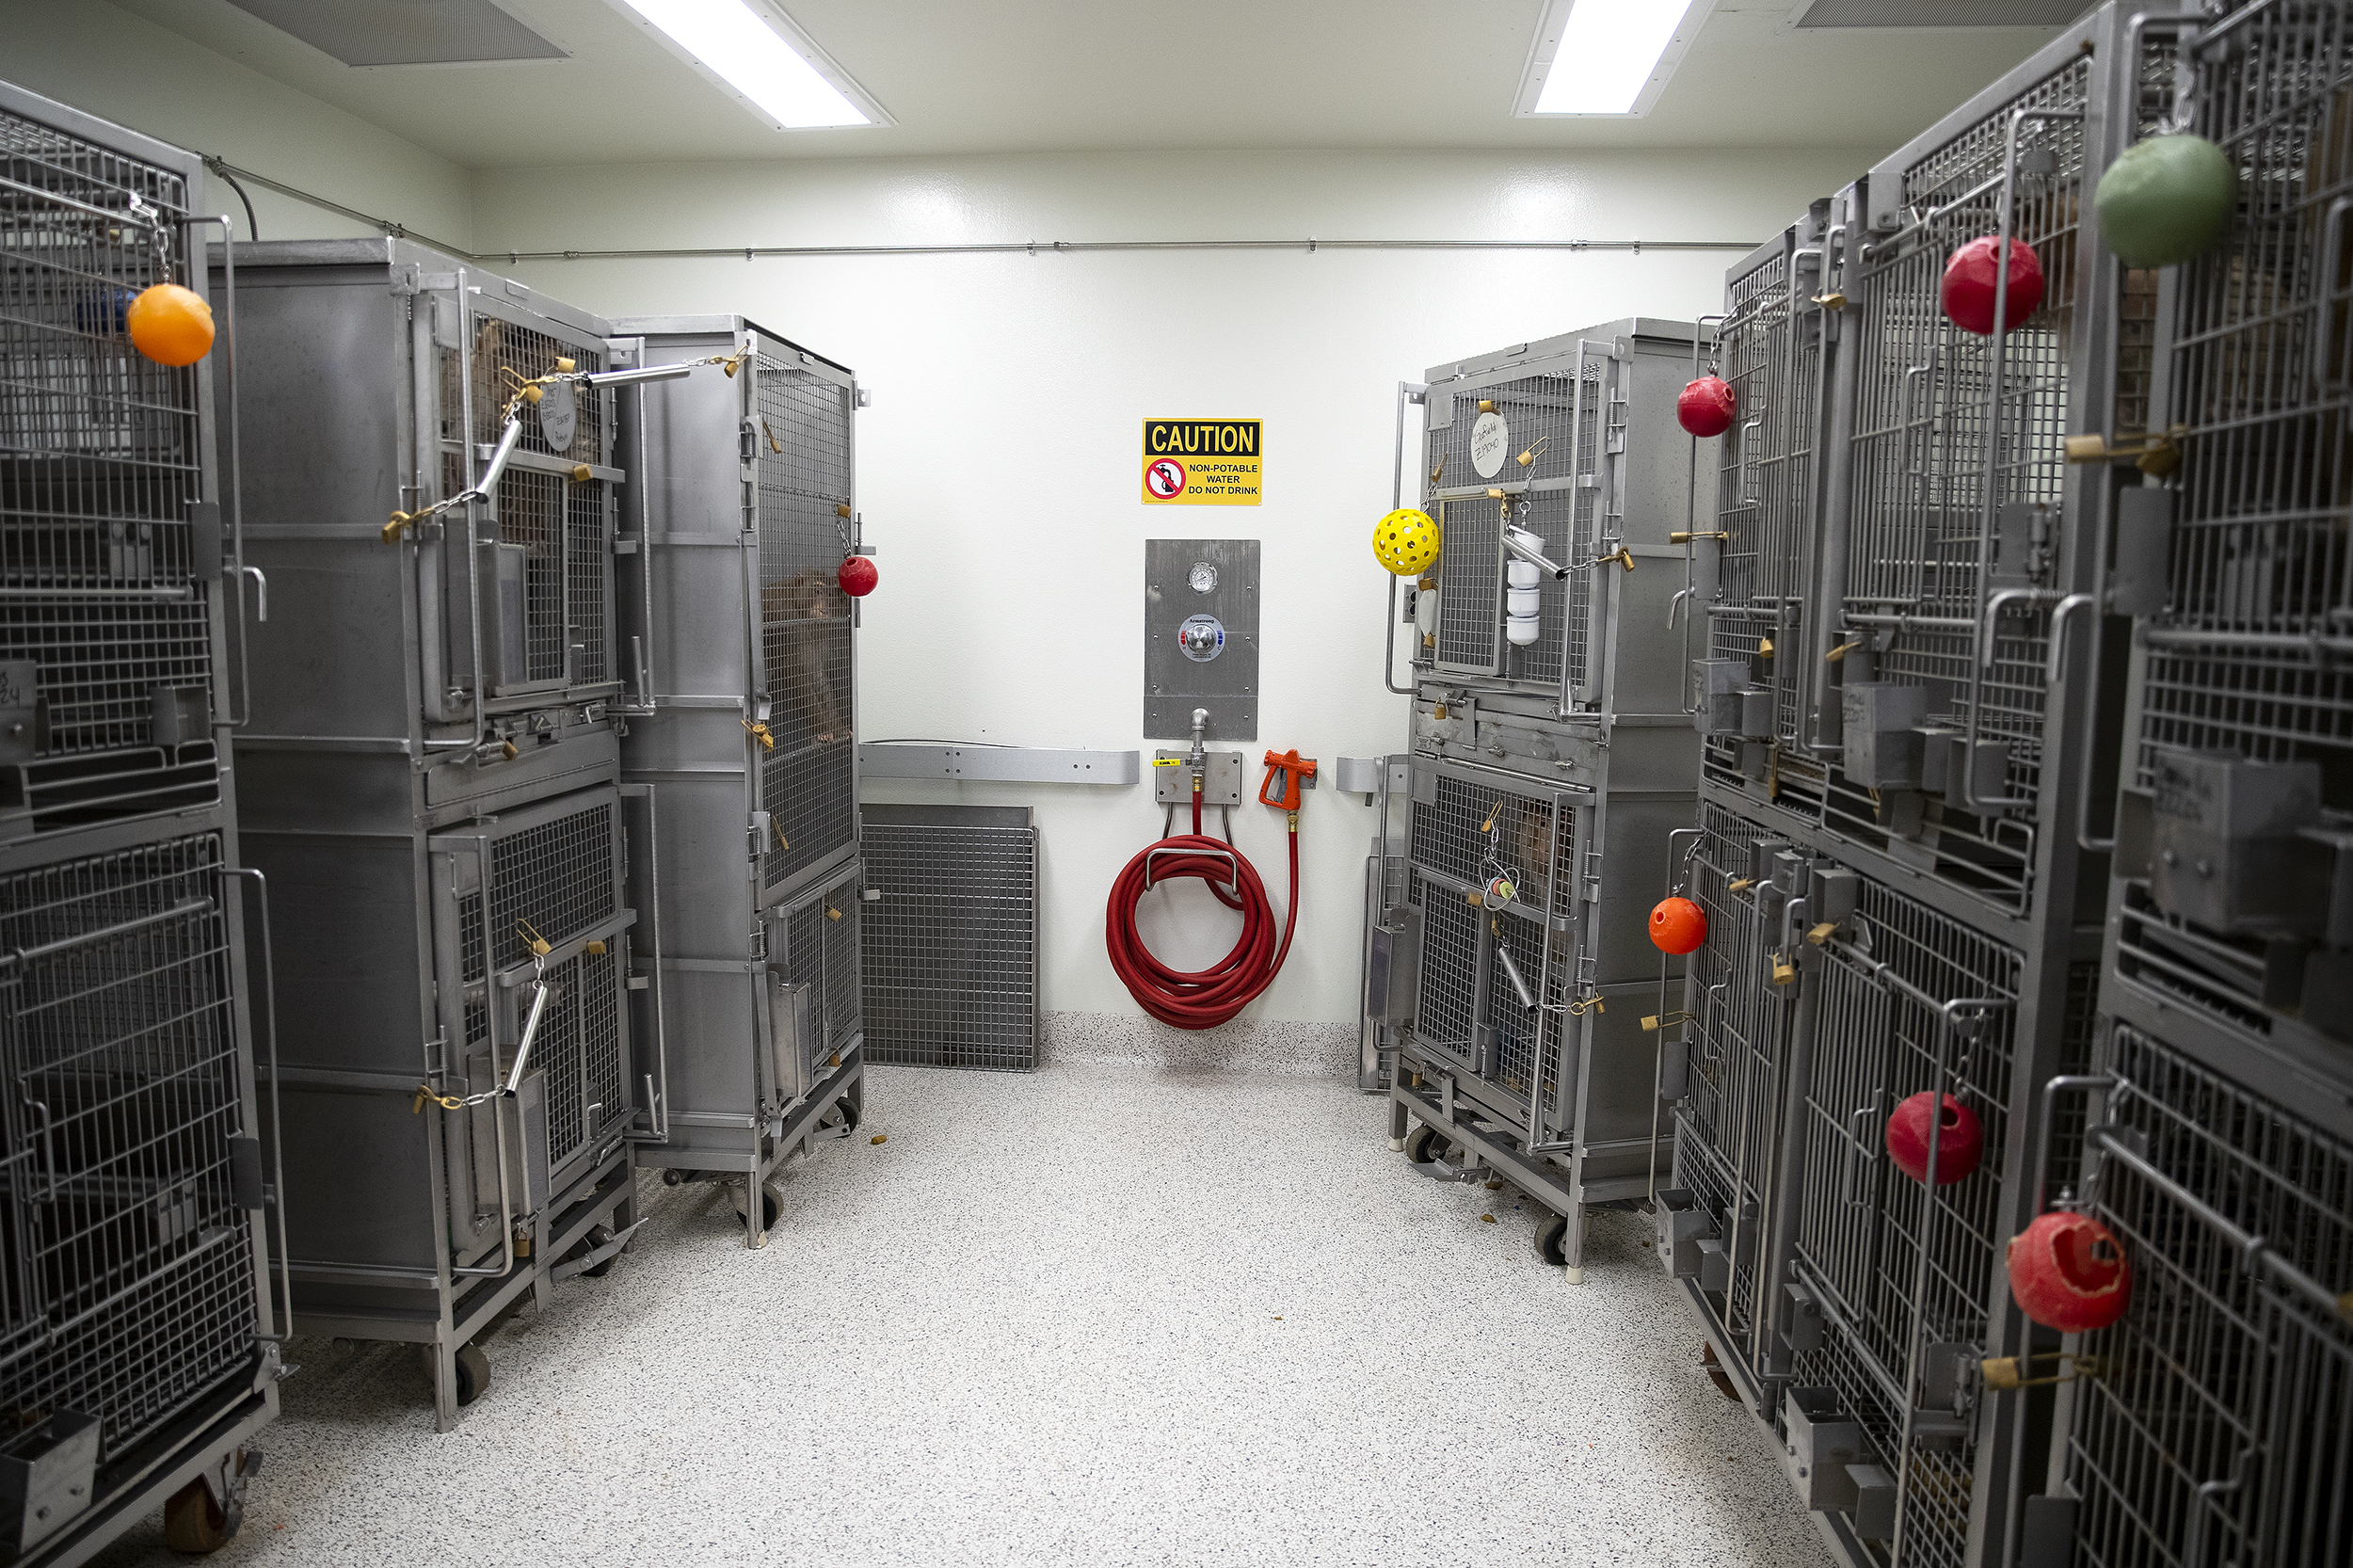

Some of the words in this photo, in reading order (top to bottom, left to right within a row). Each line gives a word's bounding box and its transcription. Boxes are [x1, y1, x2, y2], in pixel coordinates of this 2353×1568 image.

[1152, 424, 1254, 453] CAUTION
[1189, 463, 1258, 472] NON-POTABLE
[1206, 474, 1241, 484] WATER
[1189, 486, 1203, 494] DO
[1206, 486, 1225, 495] NOT
[1227, 487, 1258, 495] DRINK
